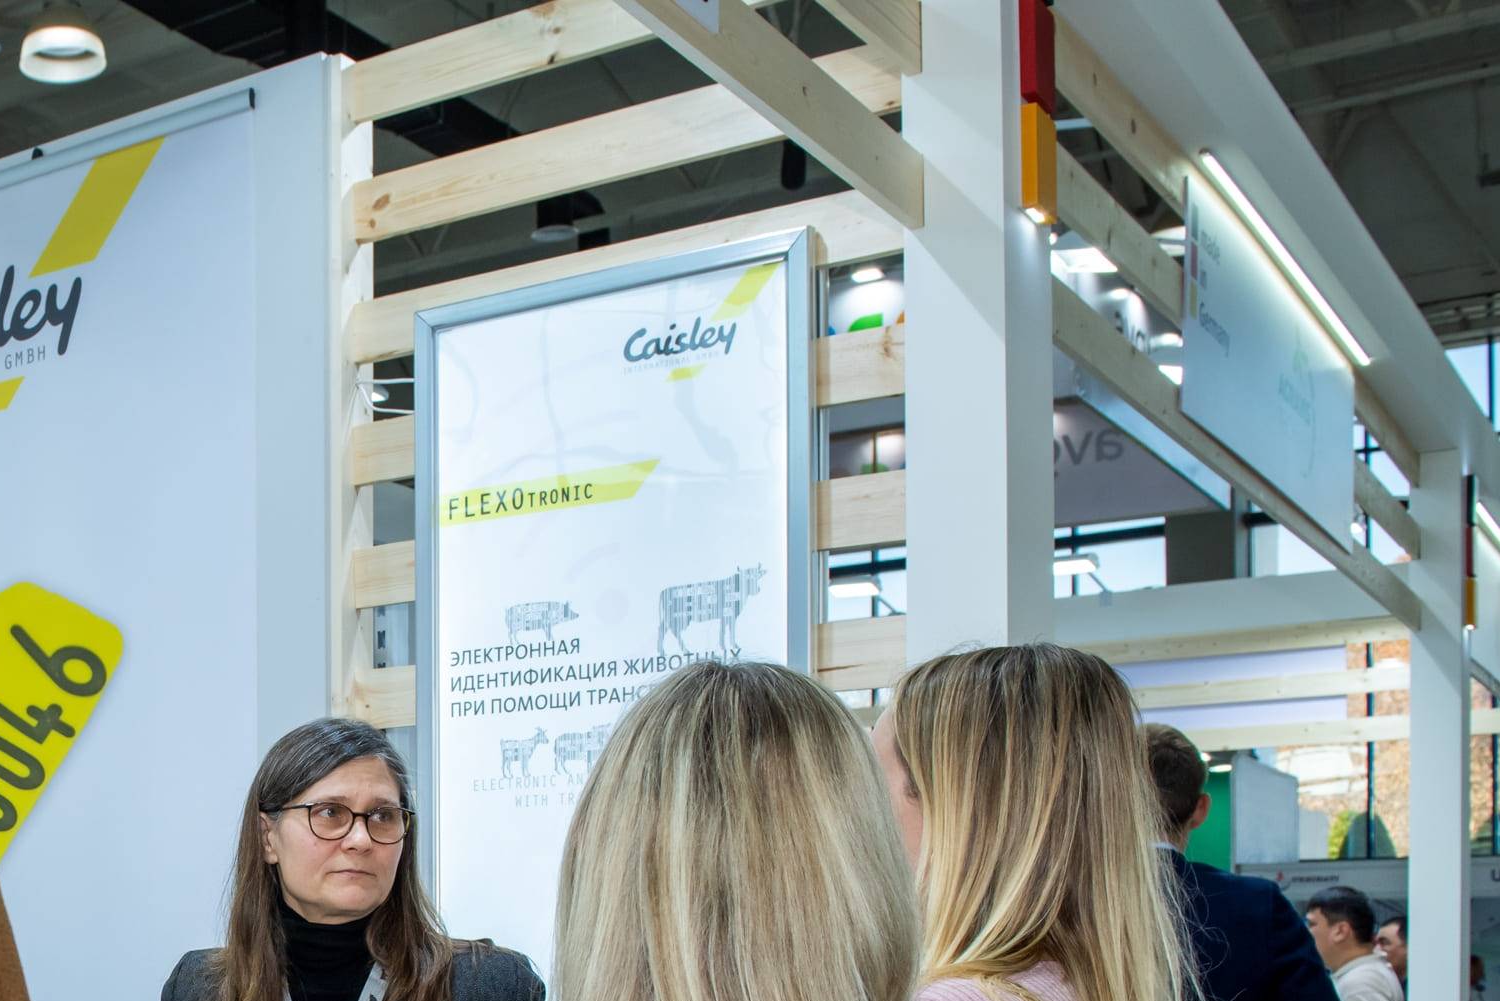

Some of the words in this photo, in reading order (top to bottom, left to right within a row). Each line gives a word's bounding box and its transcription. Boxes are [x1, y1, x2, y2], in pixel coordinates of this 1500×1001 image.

[623, 316, 738, 364] Caisley
[4, 345, 47, 370] GMBH
[450, 637, 581, 667] ЭЛЕКТРОННАЯ
[450, 660, 618, 693] ИДЕНТИФИКАЦИЯ
[451, 700, 485, 718] ПРИ
[491, 690, 582, 715] ПОМОЩИ
